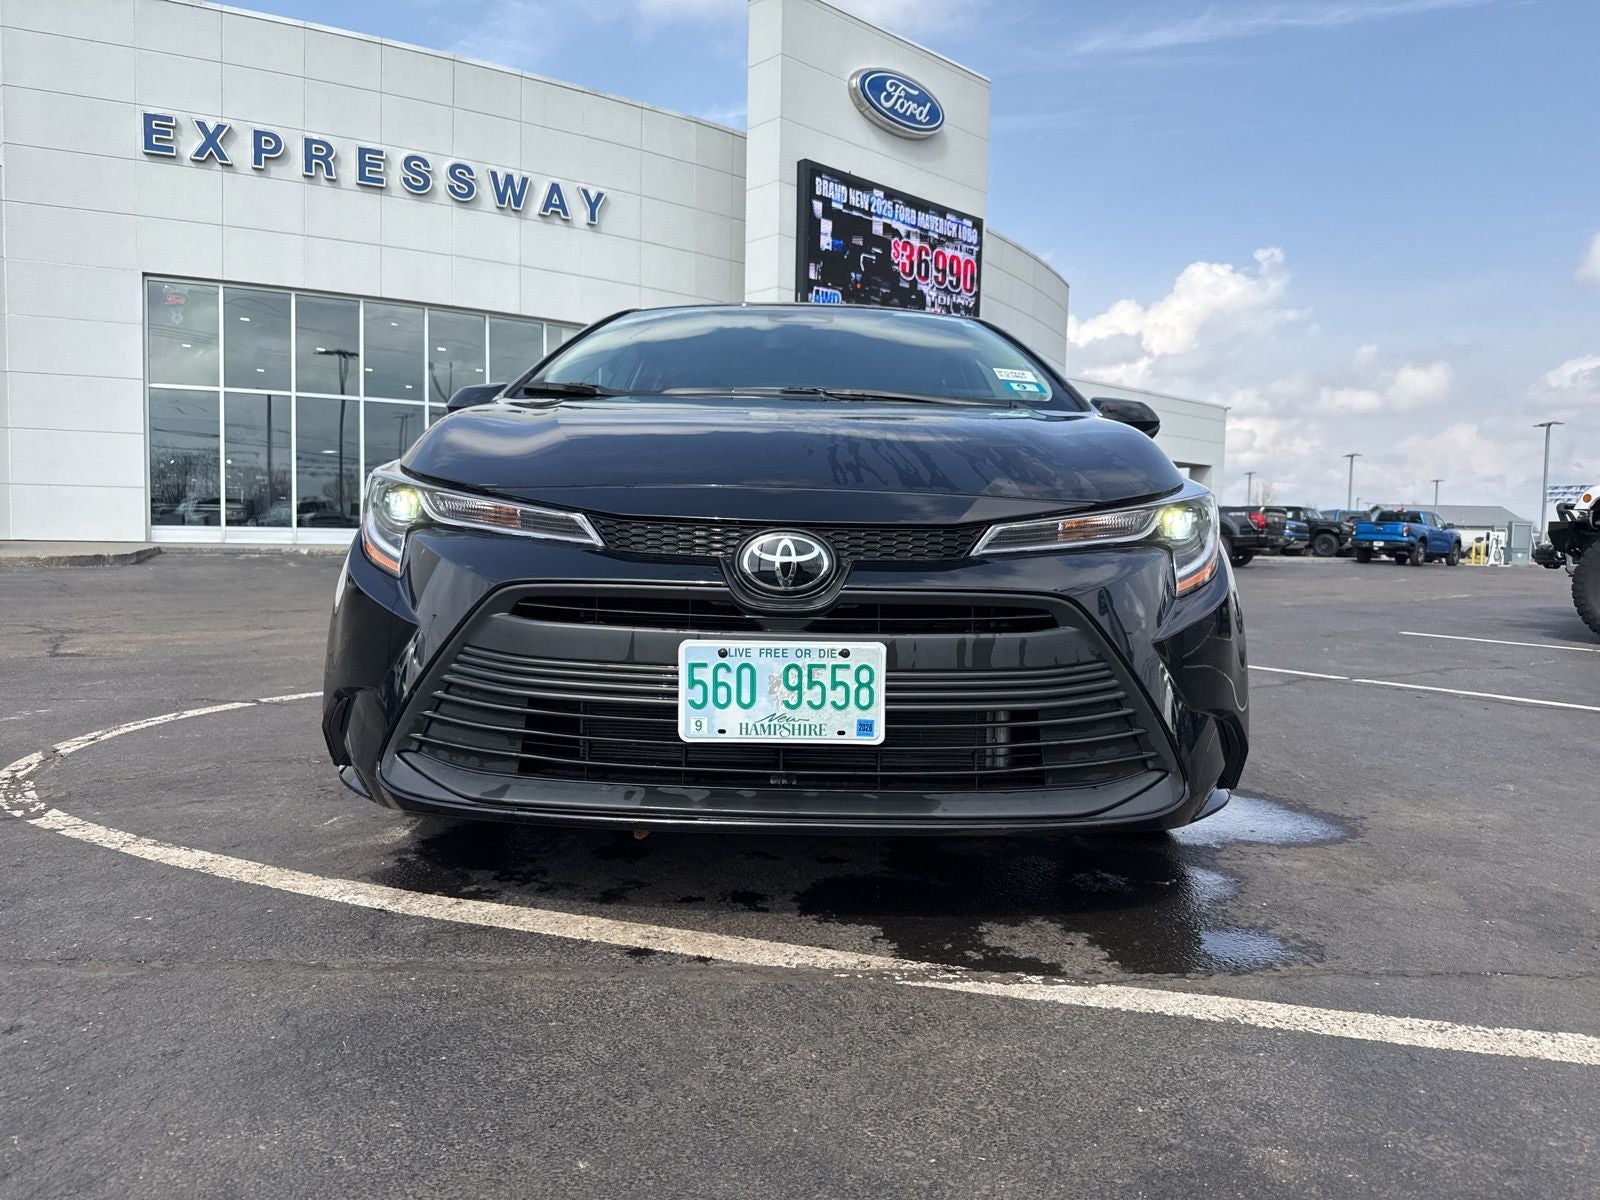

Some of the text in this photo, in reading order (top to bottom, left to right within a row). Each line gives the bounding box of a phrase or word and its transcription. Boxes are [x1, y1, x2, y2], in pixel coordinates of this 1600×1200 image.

[880, 79, 931, 123] Ford
[141, 111, 608, 226] EXPRESSWAY
[815, 176, 978, 246] BRAND NEW 2025 FORD MAVERICK LOBO
[728, 648, 838, 659] LIVE FREE OR DIE
[687, 662, 875, 711] 560 9558
[694, 719, 703, 732] 9
[738, 722, 827, 738] HAMPSHIRE
[755, 712, 810, 724] New
